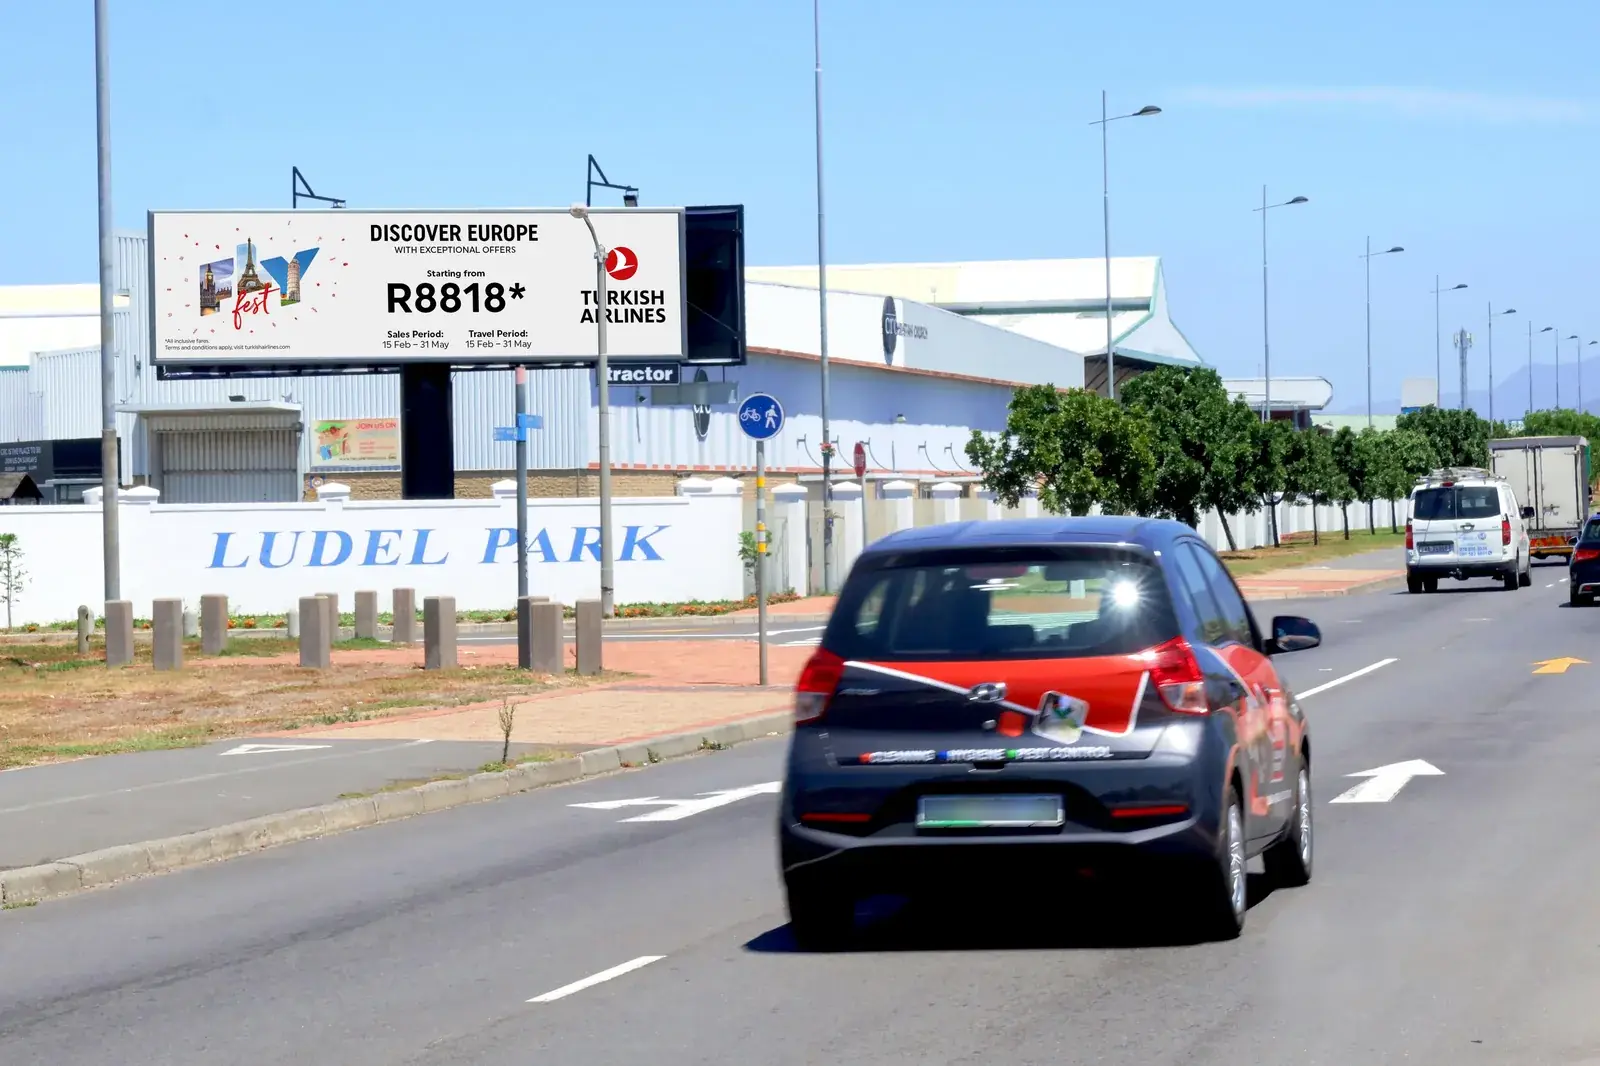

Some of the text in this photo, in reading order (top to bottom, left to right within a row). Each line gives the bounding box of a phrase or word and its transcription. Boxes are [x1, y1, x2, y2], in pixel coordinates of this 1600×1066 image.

[370, 223, 539, 242] DISCOVER EUROPE
[393, 245, 517, 254] WITH EXCEPTIONAL OFFERS
[426, 269, 486, 280] Starting from
[232, 282, 281, 331] fest
[580, 307, 666, 324] AIRLINES
[387, 329, 444, 339] Sales Period:
[468, 329, 529, 338] Travel Period:
[382, 340, 393, 349] 15
[394, 340, 412, 349] Feb
[420, 340, 430, 349] 31
[431, 340, 450, 351] May
[465, 339, 476, 349] 15
[476, 339, 494, 349] Feb
[502, 339, 512, 348] 31
[513, 339, 533, 350] May
[606, 366, 673, 382] tractor
[356, 422, 373, 430] JOIN
[205, 524, 672, 569] LUDEL PARK
